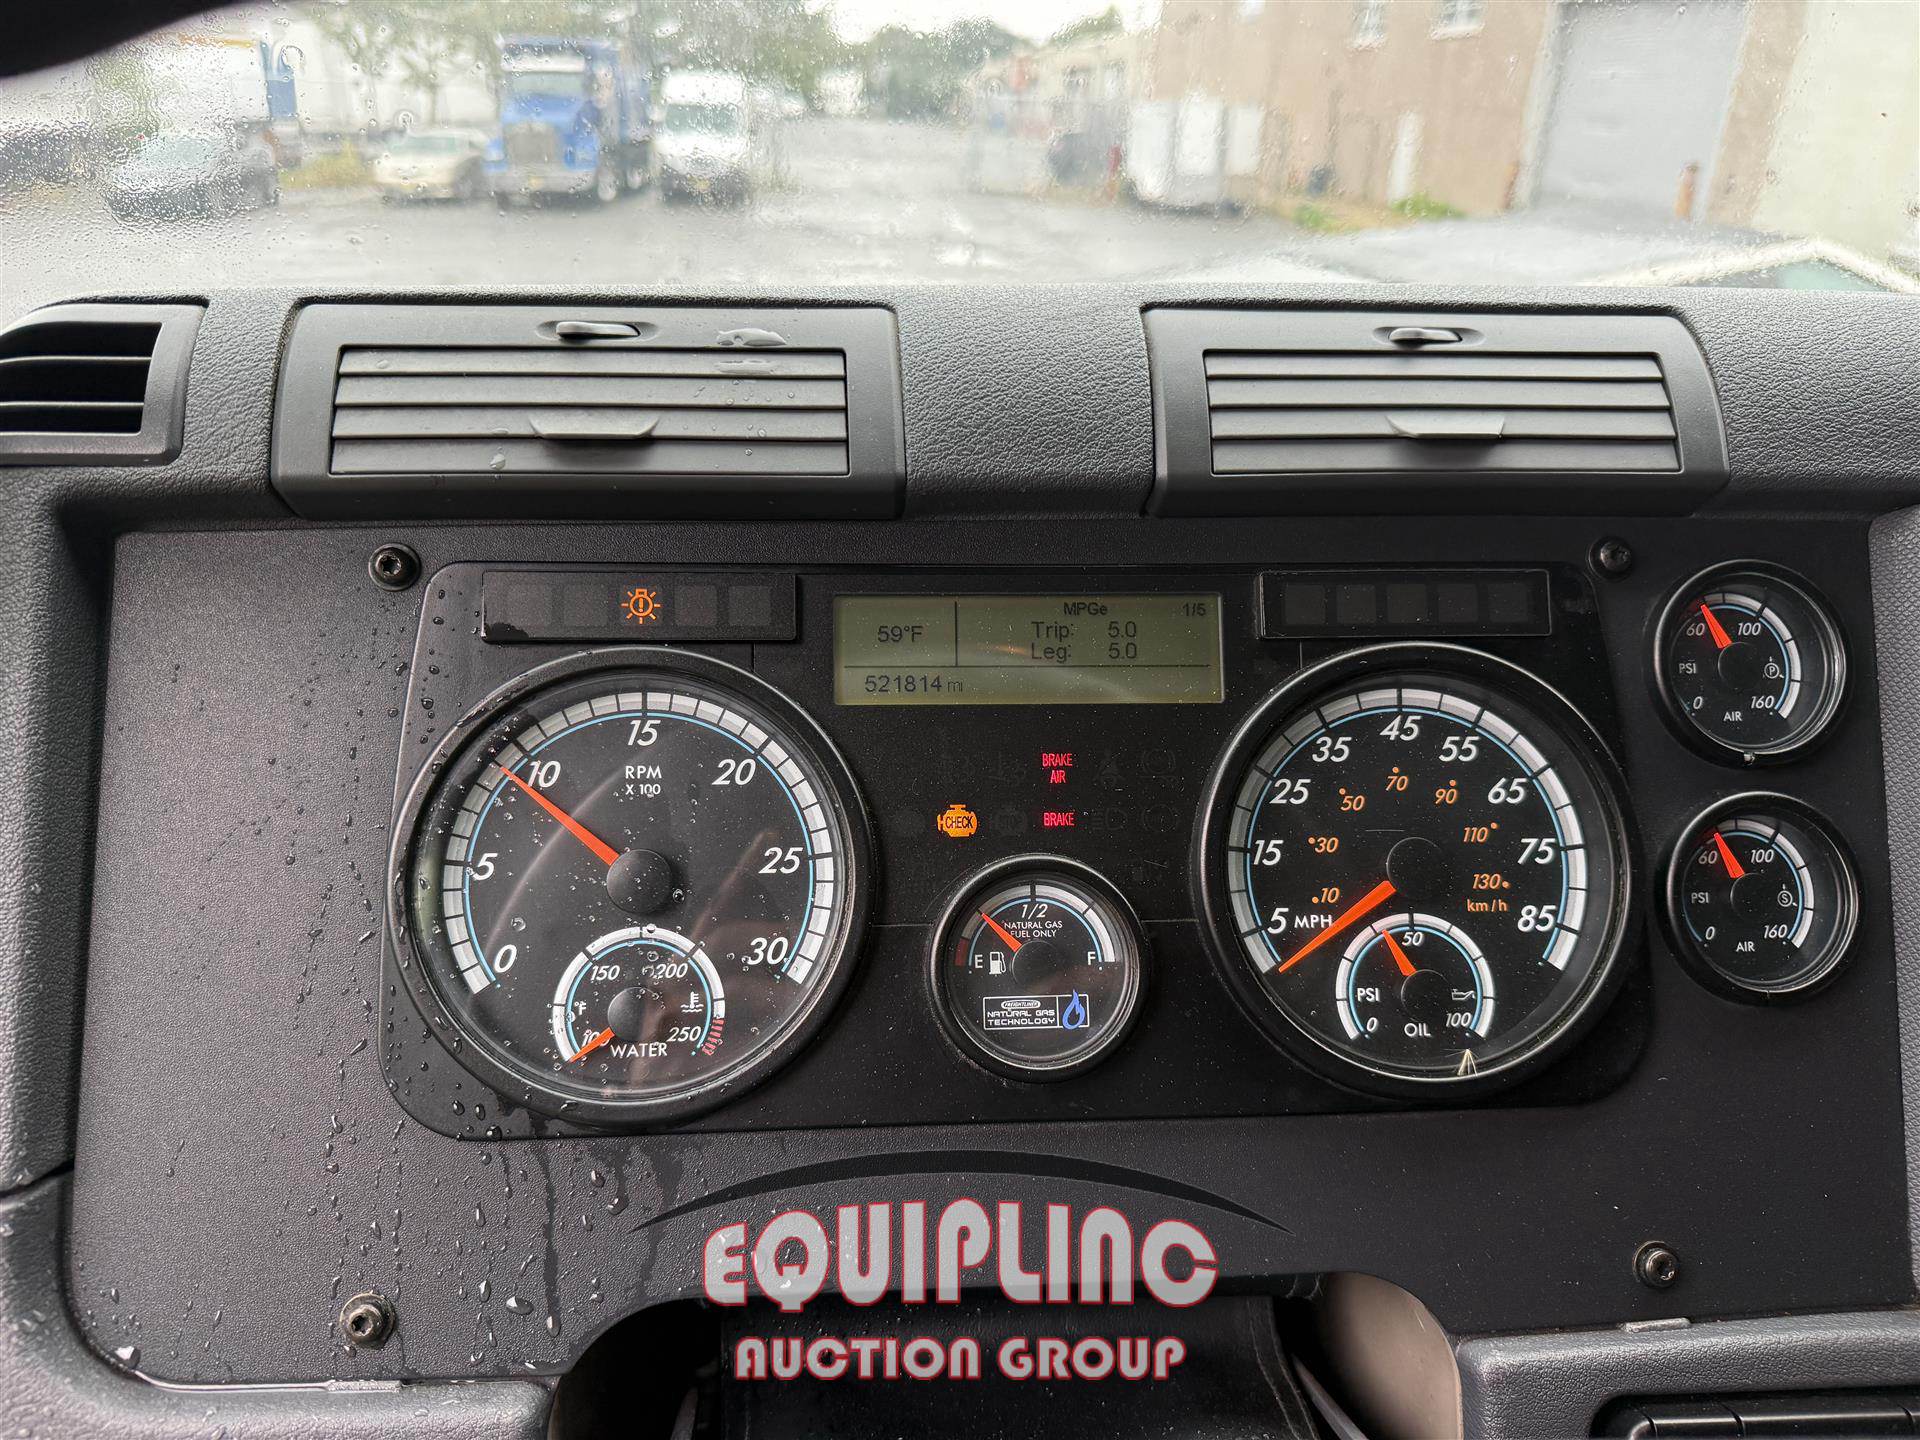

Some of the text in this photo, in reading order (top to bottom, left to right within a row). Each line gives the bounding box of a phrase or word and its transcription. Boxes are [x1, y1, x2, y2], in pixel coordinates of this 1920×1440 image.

[1063, 601, 1108, 616] MPGe
[1182, 602, 1206, 616] 1/5
[877, 625, 924, 643] 59°F
[1031, 621, 1137, 642] Trip: 5.0
[1686, 622, 1705, 636] 60
[1737, 622, 1761, 636] 100
[1030, 642, 1138, 663] Leg: 5.0
[1679, 663, 1697, 674] PSI
[865, 675, 942, 693] 521814
[1693, 696, 1703, 709] 0
[1751, 695, 1774, 709] 160
[1723, 711, 1743, 721] AIR
[627, 719, 661, 747] 15
[1380, 715, 1421, 741] 45
[1312, 736, 1352, 763] 35
[1438, 736, 1479, 762] 55
[1042, 753, 1073, 767] BRAKE
[527, 759, 561, 788] 10
[625, 765, 662, 780] RPM
[712, 758, 756, 786] 20
[1050, 769, 1066, 784] AIR
[626, 783, 661, 795] X 100
[1385, 775, 1408, 791] 70
[1487, 777, 1527, 805] 65
[1270, 778, 1311, 805] 25
[1435, 788, 1457, 804] 90
[1340, 795, 1365, 812] 50
[945, 815, 974, 829] CHECK
[1043, 812, 1075, 826] BRAKE
[1463, 826, 1488, 843] 110
[1253, 839, 1284, 866] 15
[1313, 837, 1339, 854] 30
[1517, 837, 1556, 865] 75
[758, 847, 803, 875] 25
[1698, 850, 1717, 864] 60
[1750, 849, 1774, 863] 100
[471, 852, 498, 881] 5
[1472, 874, 1501, 890] 130
[1318, 887, 1340, 903] 10
[1691, 892, 1709, 903] PSI
[1020, 904, 1048, 918] 1/2
[1467, 899, 1508, 913] km/h
[1004, 920, 1063, 930] NATURAL GAS
[1267, 907, 1289, 934] 5
[1294, 915, 1332, 928] MPH
[1517, 904, 1556, 932] 85
[1010, 929, 1057, 938] FUEL ONLY
[1401, 931, 1424, 946] 50
[1705, 926, 1715, 940] 0
[1764, 925, 1788, 939] 160
[746, 937, 789, 966] 30
[1736, 942, 1755, 952] AIR
[494, 944, 518, 973] 0
[974, 954, 983, 969] E
[1087, 951, 1096, 965] F
[590, 964, 620, 981] 150
[655, 963, 688, 979] 200
[1357, 988, 1380, 1002] PSI
[987, 1009, 1055, 1018] NATURAL GAS
[987, 1017, 1055, 1026] TECHNOLOGY
[1445, 1012, 1471, 1028] 100
[1366, 1017, 1378, 1033] 0
[1404, 1023, 1431, 1038] OIL
[666, 1026, 701, 1043] 250
[610, 1042, 668, 1058] WATER
